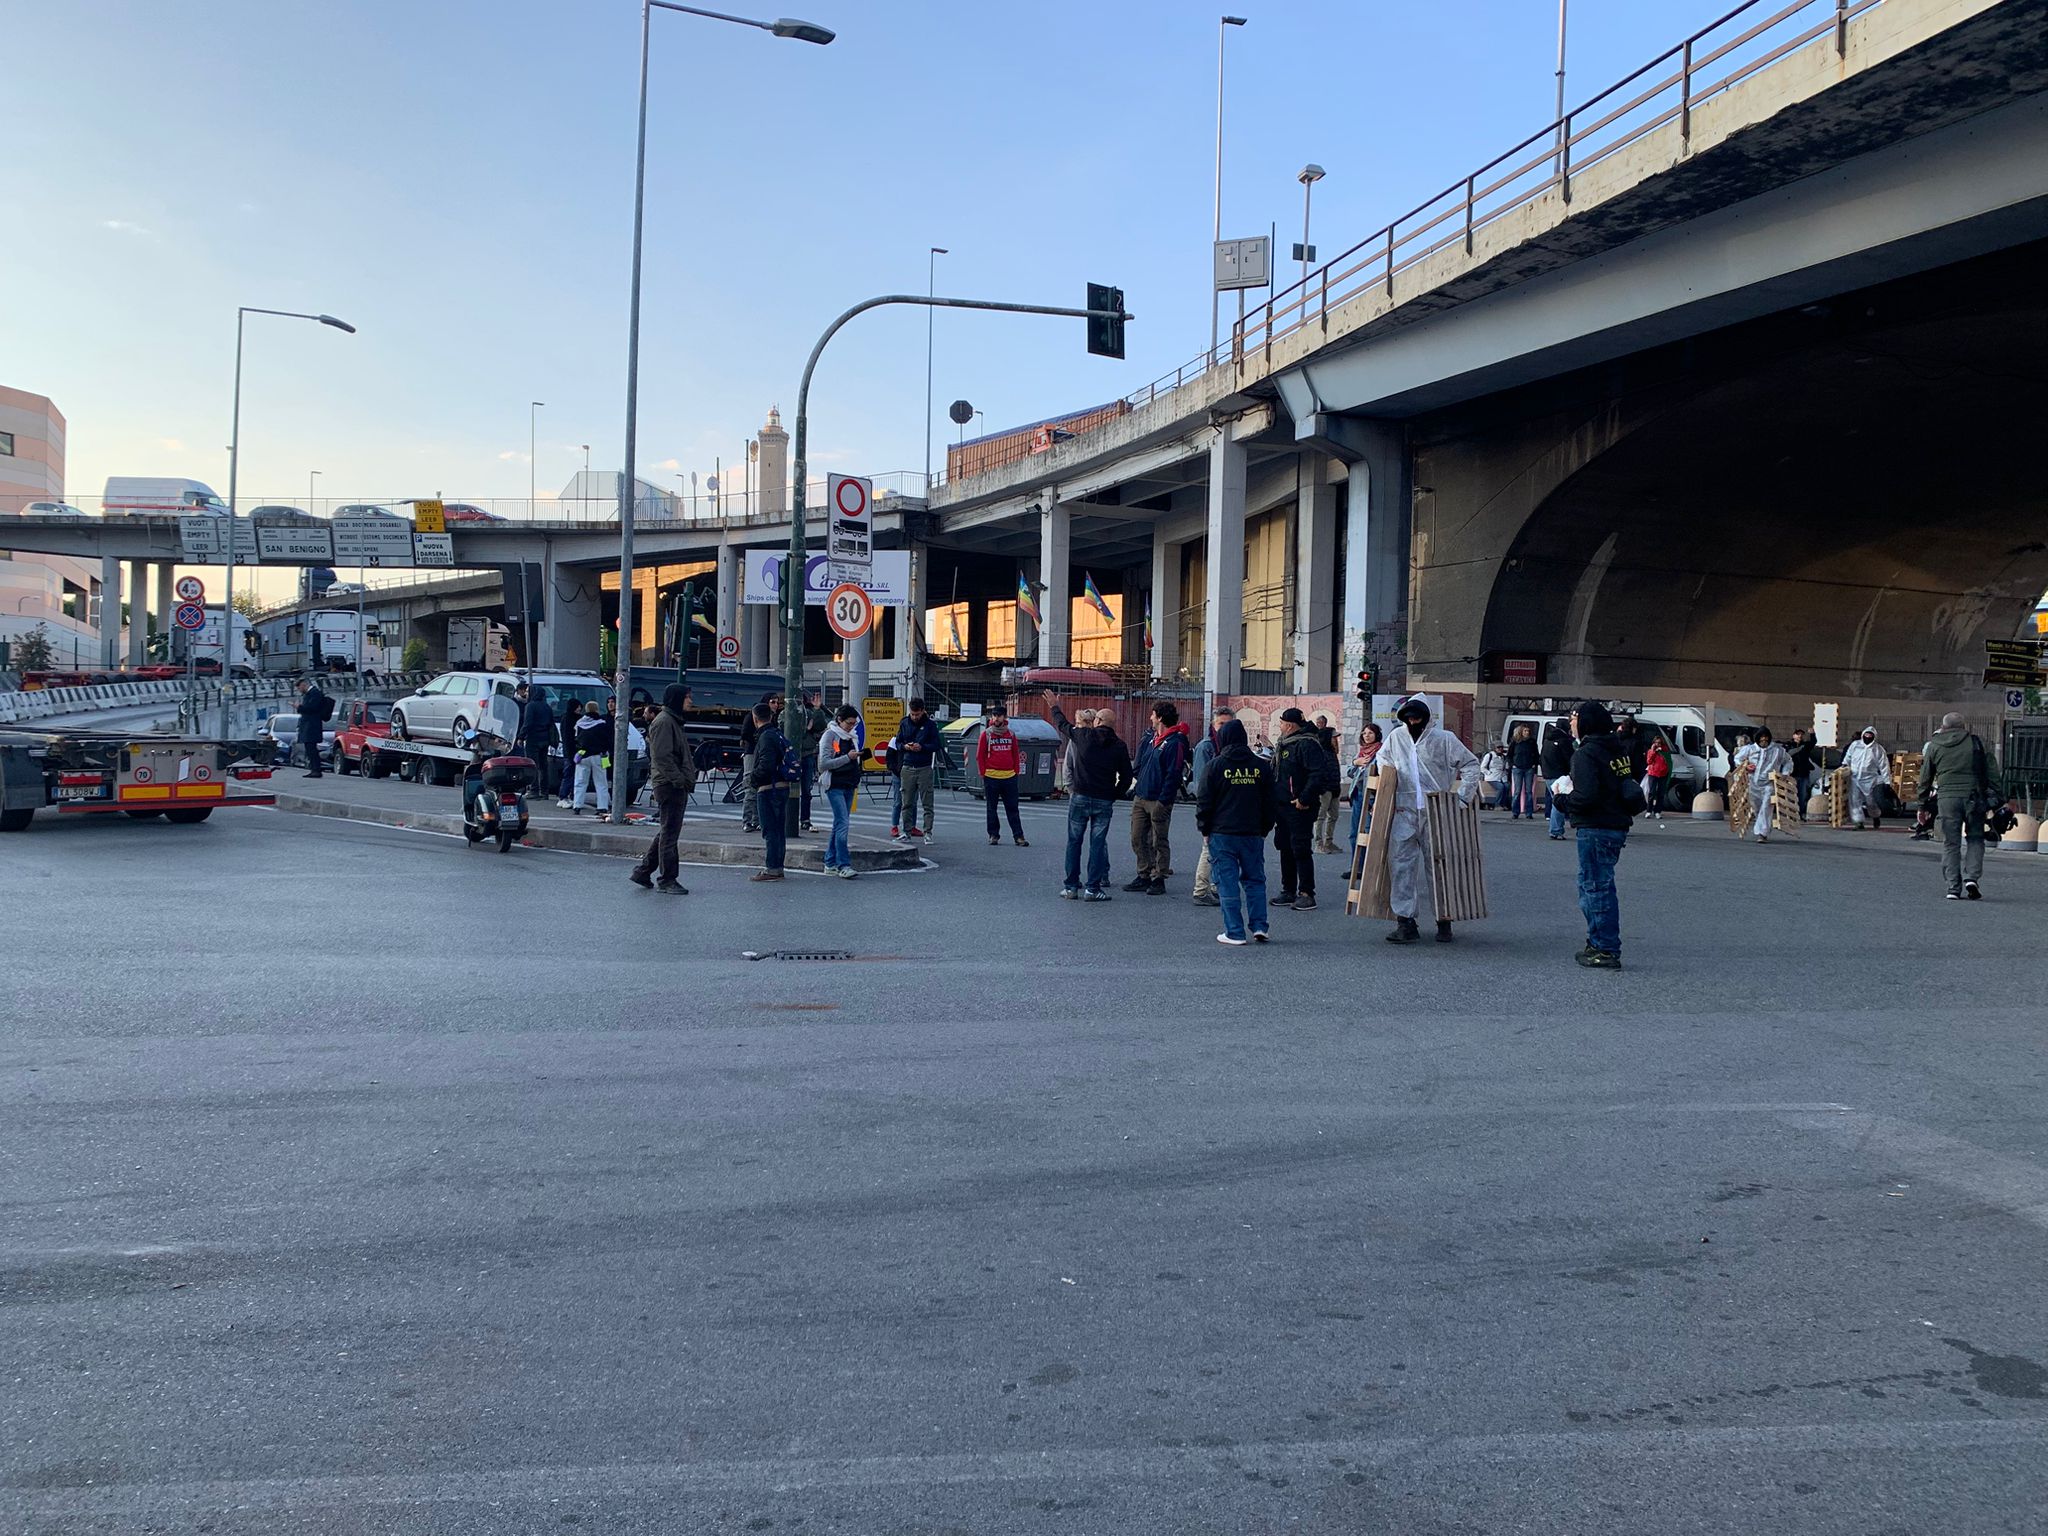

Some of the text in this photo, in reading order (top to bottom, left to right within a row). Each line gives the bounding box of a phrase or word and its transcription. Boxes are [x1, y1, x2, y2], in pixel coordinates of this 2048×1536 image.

[187, 519, 209, 527] VUOTI
[186, 531, 211, 539] EMPTY
[191, 543, 209, 551] LEER
[265, 544, 283, 553] SAN
[288, 545, 327, 554] BENIGNO
[746, 594, 764, 602] Ships
[836, 596, 862, 624] 30
[724, 642, 735, 652] 10
[138, 771, 148, 779] 70
